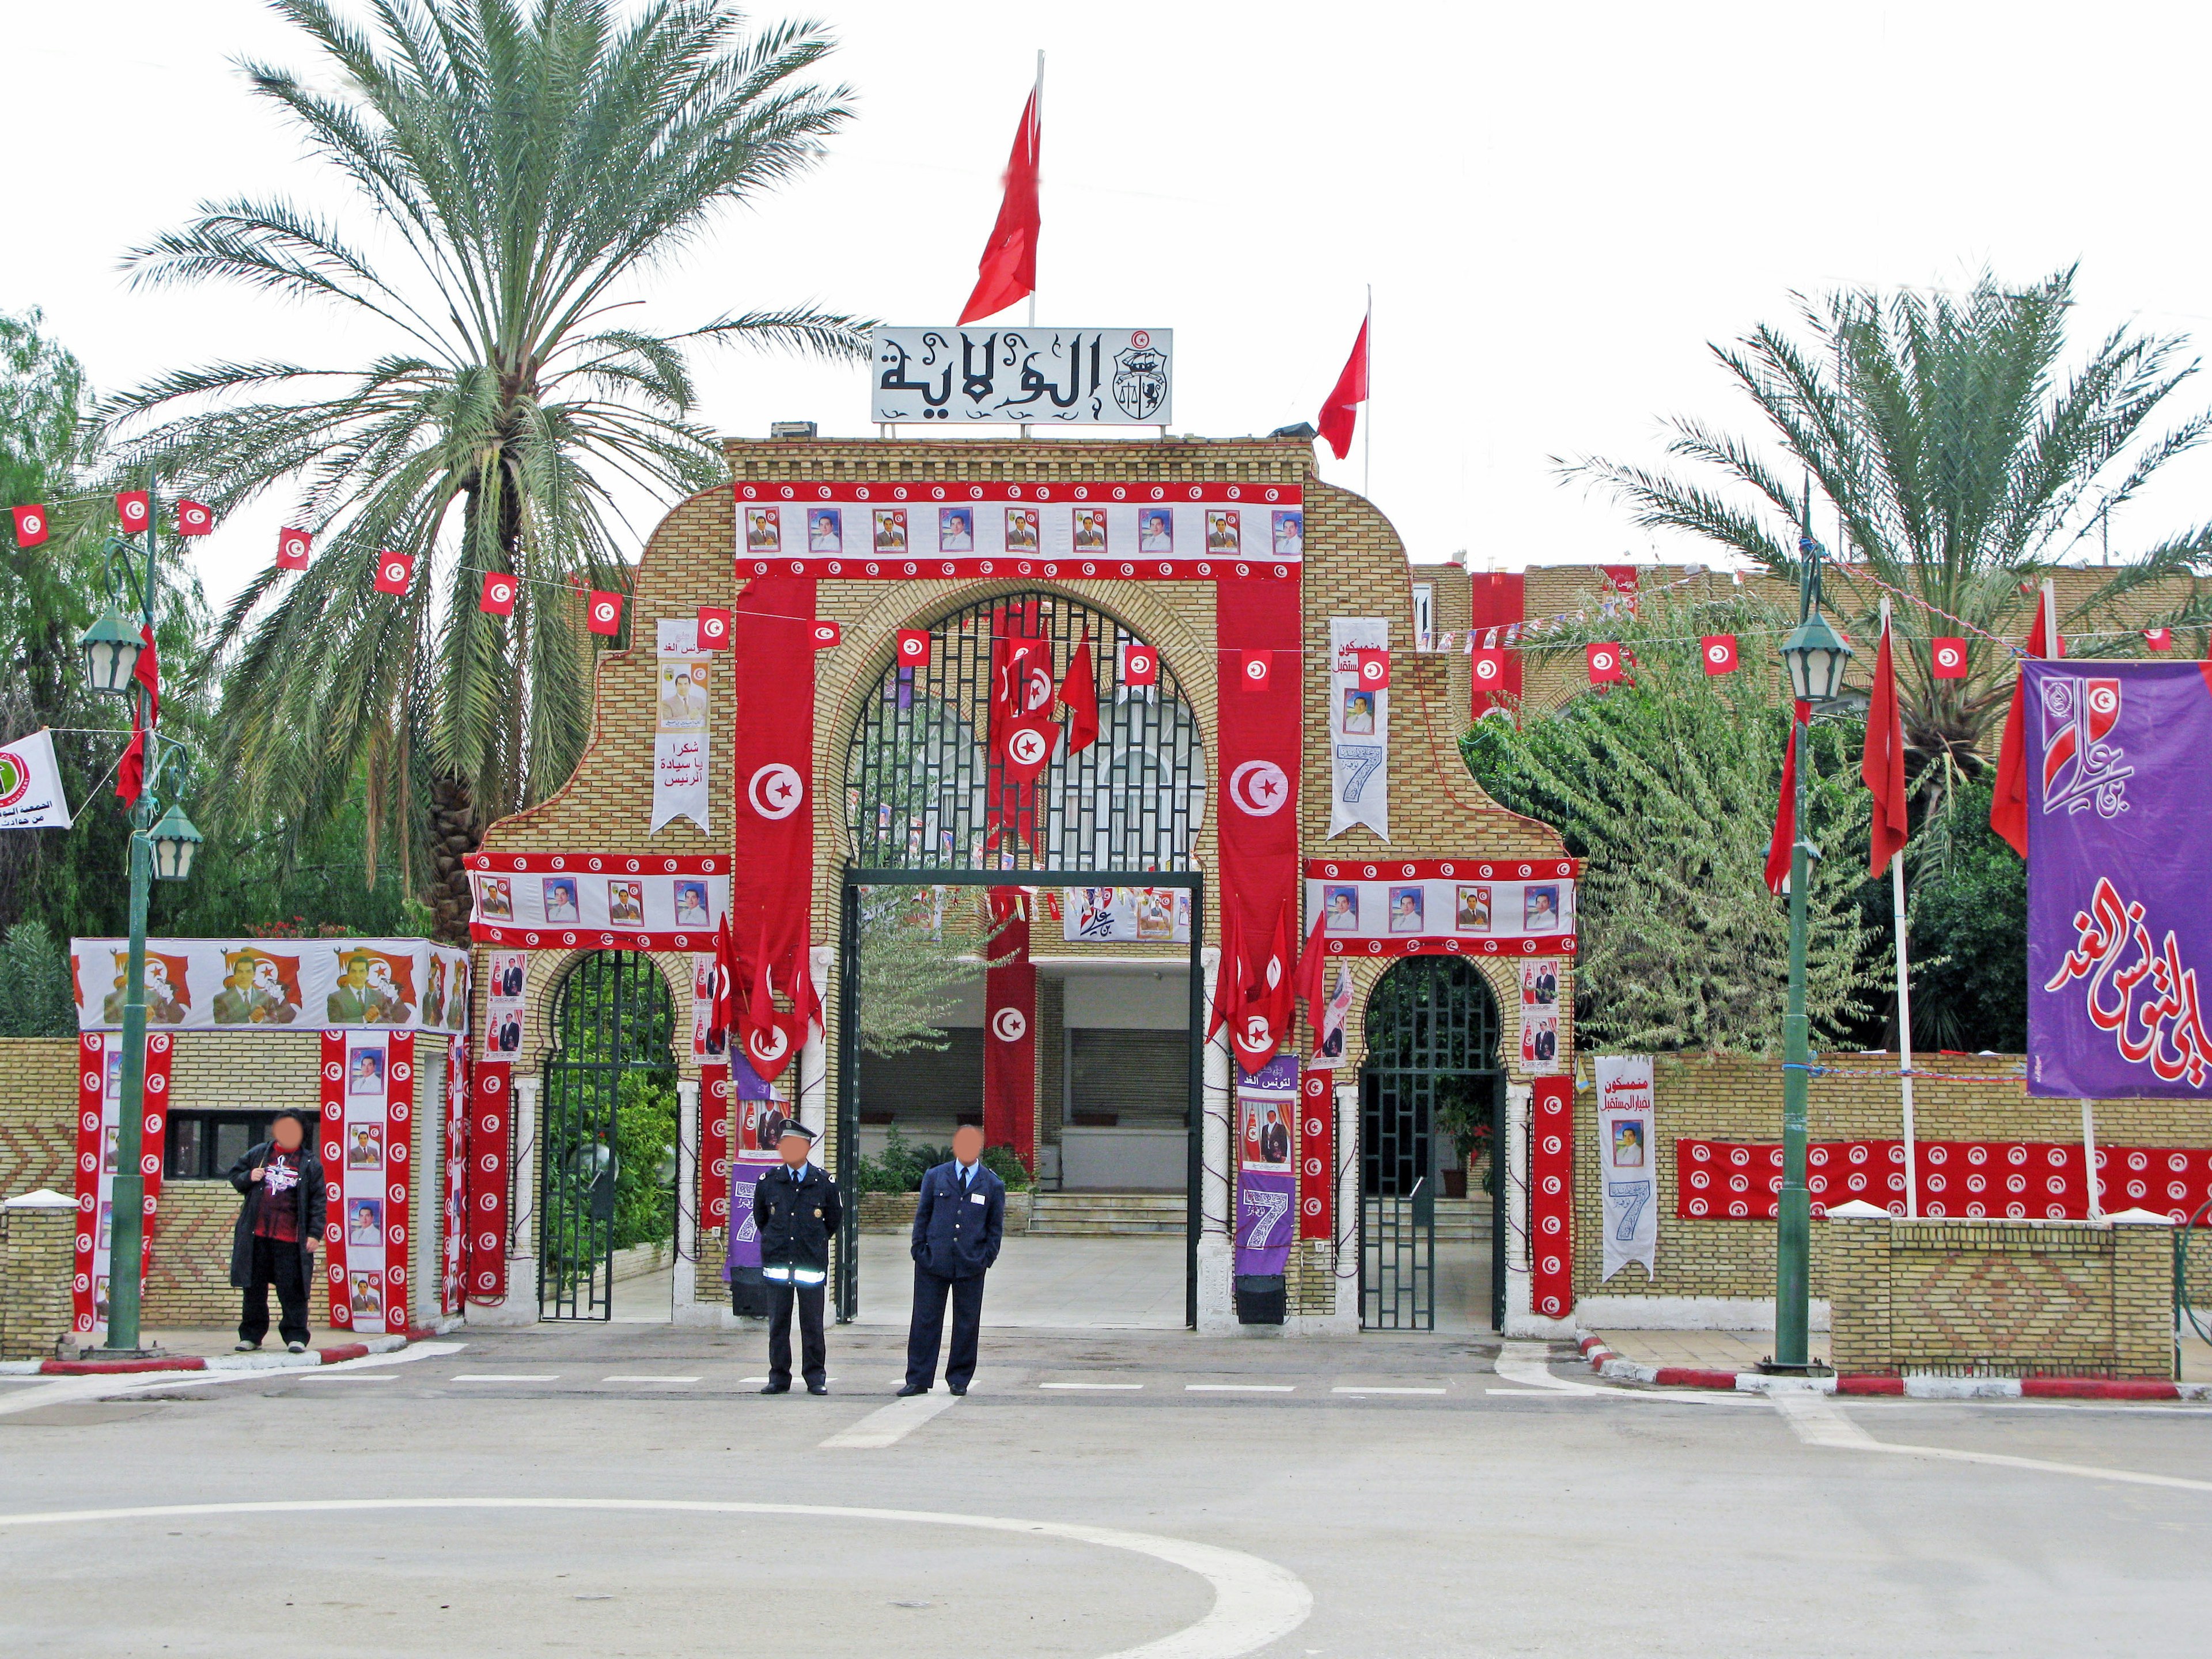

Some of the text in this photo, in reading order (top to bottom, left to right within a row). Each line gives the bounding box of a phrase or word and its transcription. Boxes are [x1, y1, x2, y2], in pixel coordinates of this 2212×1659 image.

[880, 332, 1103, 421] الولاية
[664, 643, 677, 652] الغد
[672, 741, 699, 756] شكرا
[660, 757, 703, 772] يا سيادة
[664, 771, 702, 786] الرئيس
[1337, 744, 1382, 802] 7
[20, 801, 52, 814] الجمعية
[2, 816, 44, 826] من حوادث
[1244, 1075, 1291, 1089] لتونس الغد
[1605, 1074, 1649, 1094] متمسكون
[1600, 1095, 1650, 1112] بخيار المستقبل
[1609, 1180, 1650, 1240] 7
[1243, 1189, 1289, 1250] 7
